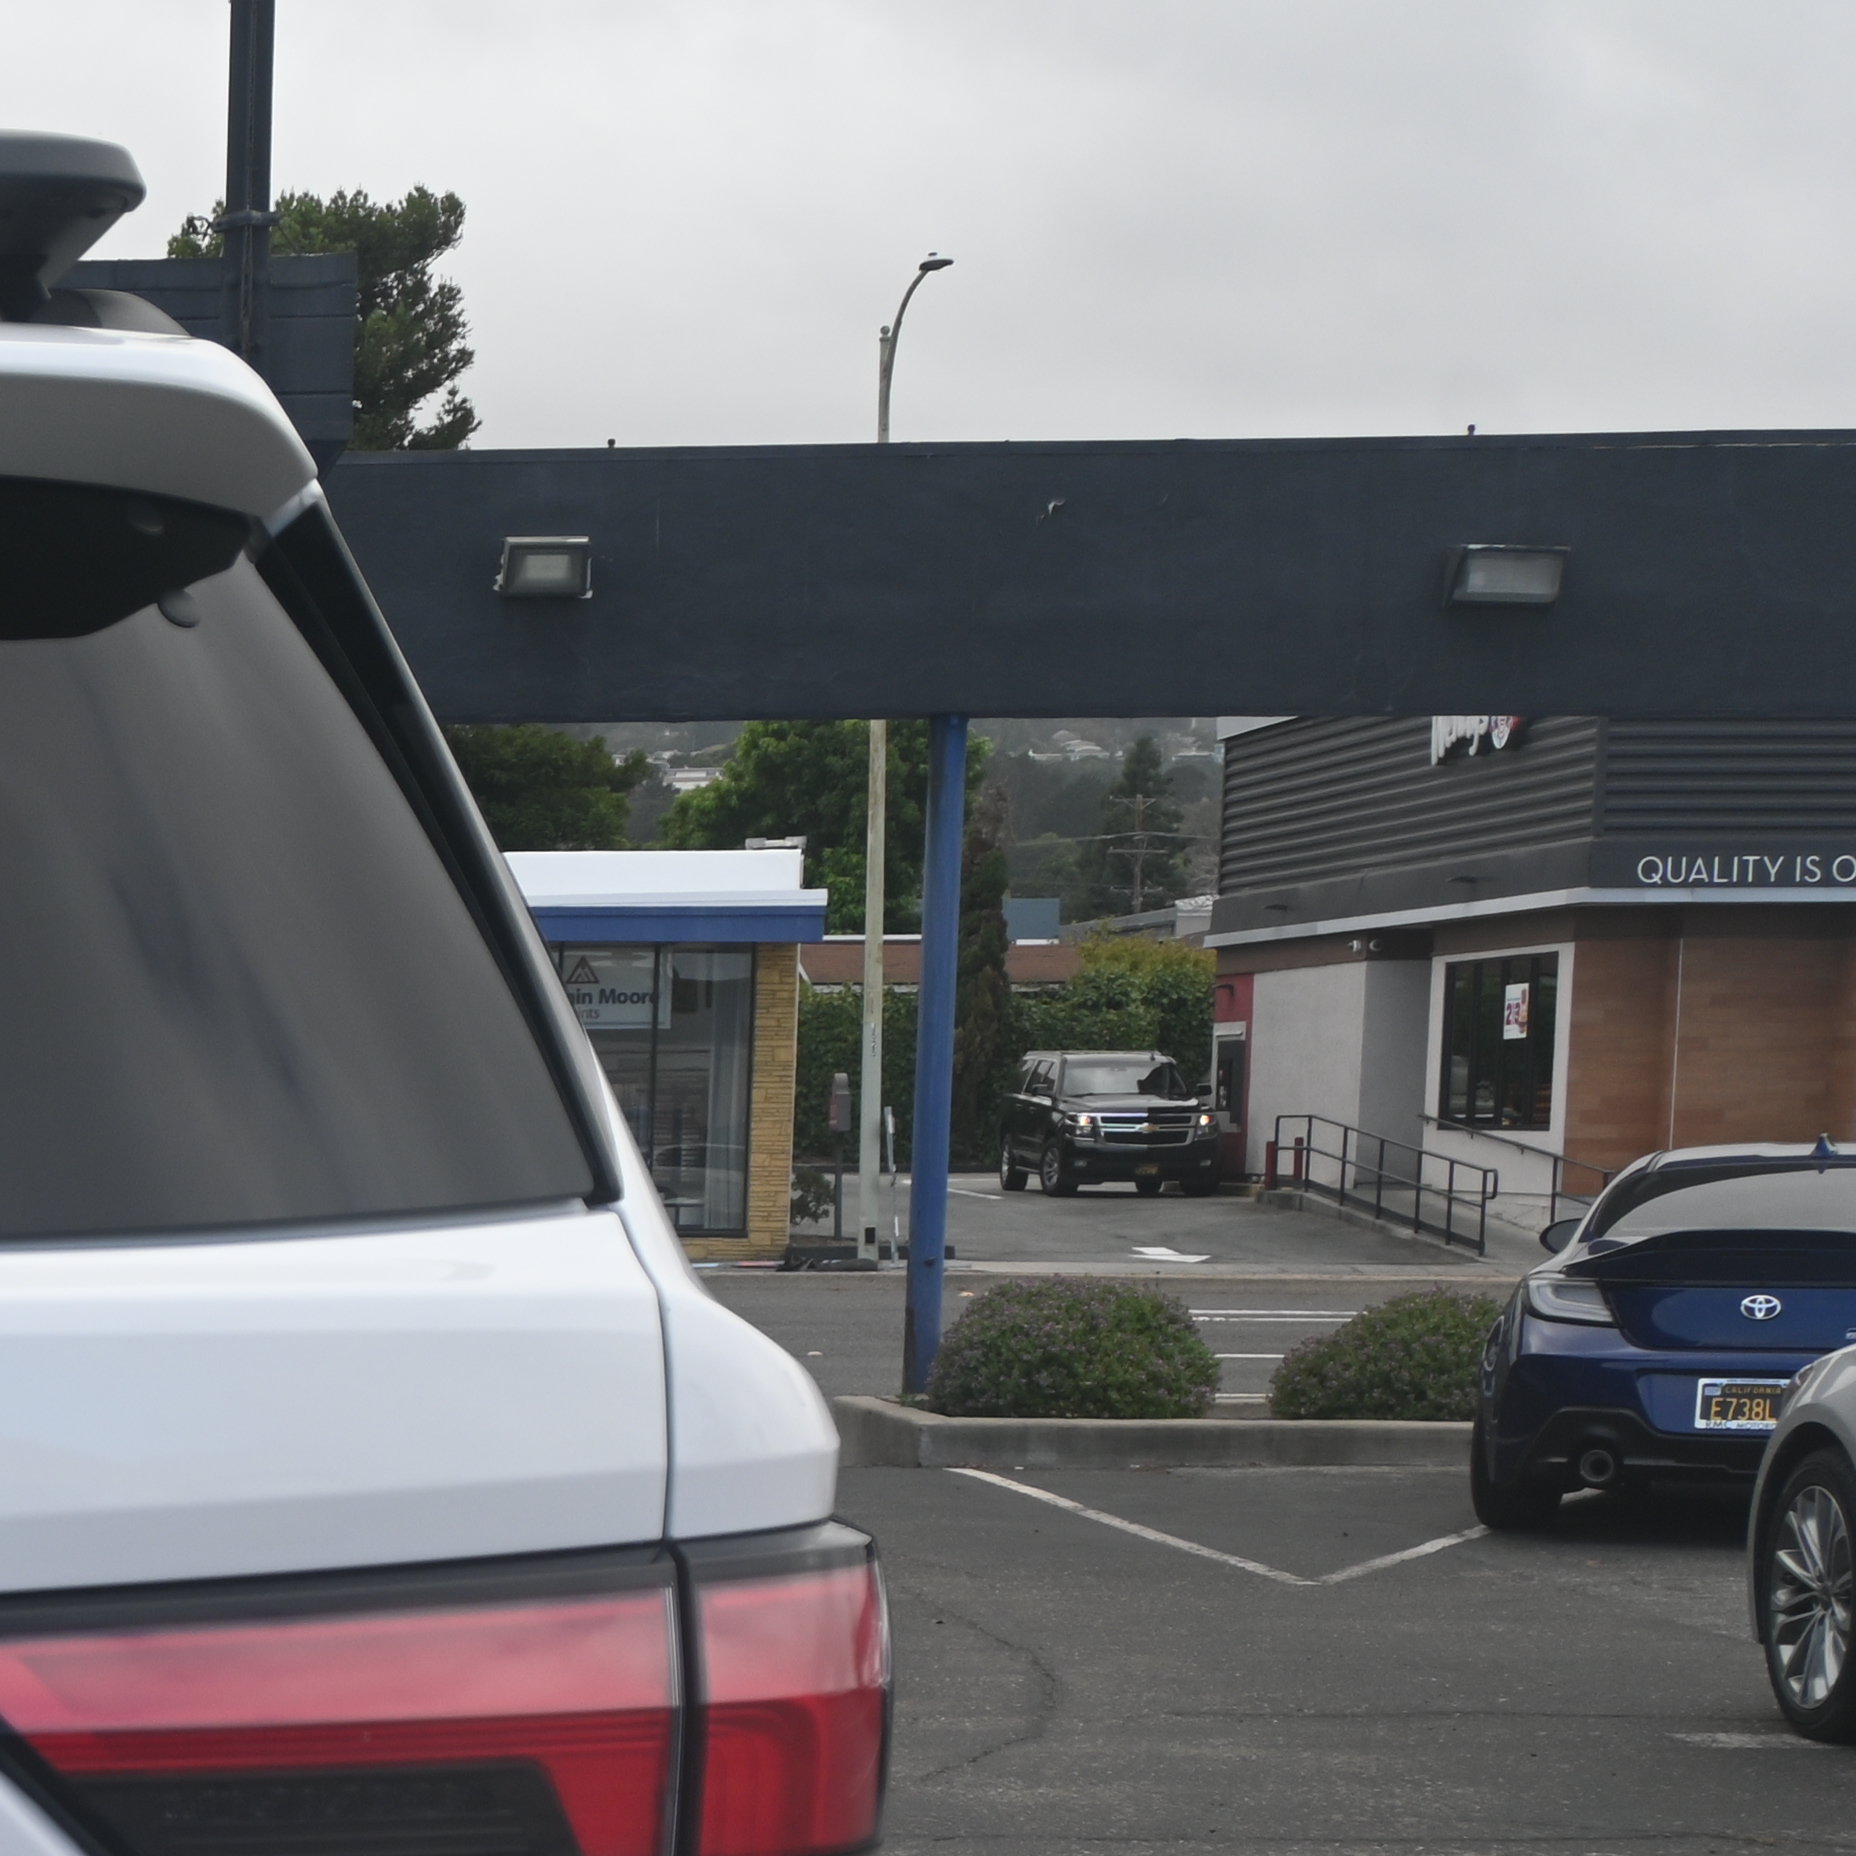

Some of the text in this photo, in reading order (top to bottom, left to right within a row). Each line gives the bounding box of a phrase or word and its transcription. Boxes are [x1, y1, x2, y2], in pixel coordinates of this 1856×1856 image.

[1637, 855, 1856, 885] QUALITY IS O
